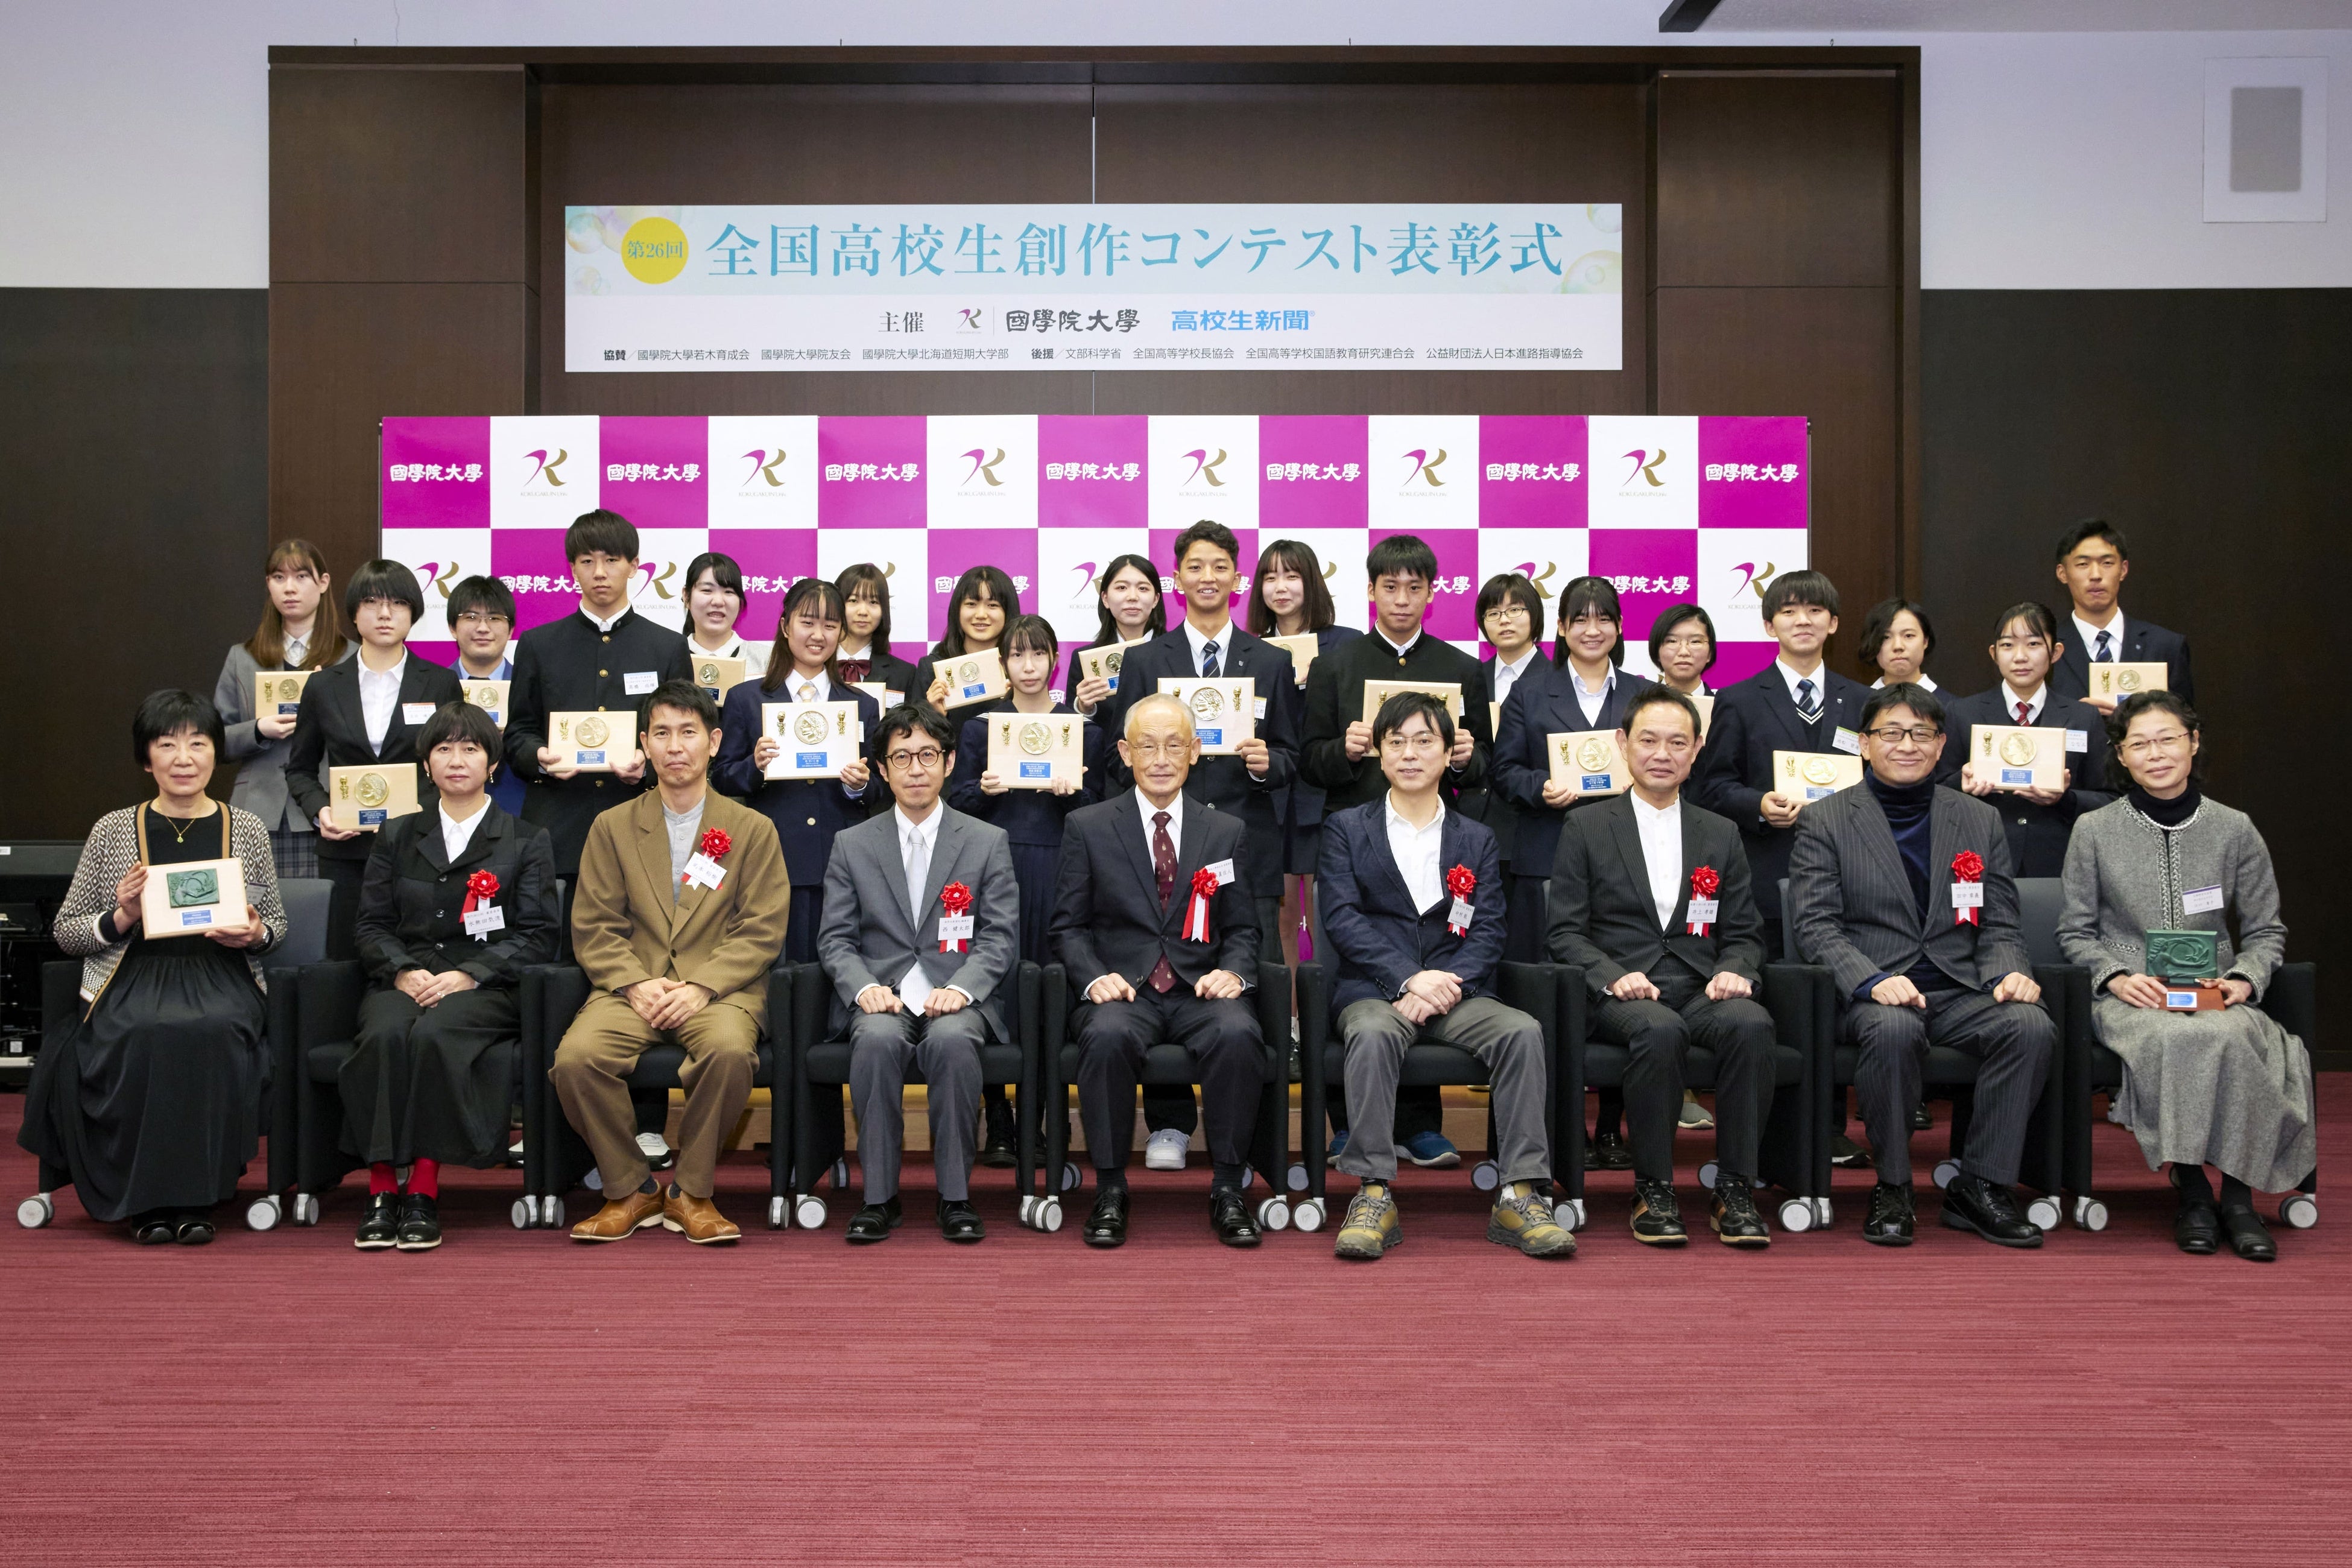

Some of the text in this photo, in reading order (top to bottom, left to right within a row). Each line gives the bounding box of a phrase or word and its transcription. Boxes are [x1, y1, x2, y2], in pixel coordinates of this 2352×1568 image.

[628, 241, 683, 258] 第26回
[706, 221, 1563, 277] 全国高校生創作コンテスト表彰式
[879, 311, 925, 334] 主催
[1006, 308, 1140, 334] 國學院大學
[761, 349, 851, 361] 國學院大學院友会
[862, 348, 1009, 360] 國學院大學北海道短期大学部
[1133, 347, 1234, 359] 全国高等学校長協会
[1245, 347, 1415, 359] 全国高等学校国語教育研究連合会
[1426, 347, 1584, 359] 公益財団法人日本進路指導協会
[390, 464, 482, 482] 國學院大學
[607, 464, 700, 482] 國學院大學
[826, 463, 919, 482] 國學院大學
[1046, 463, 1140, 481] 國學院大學
[1266, 463, 1361, 481] 國學院大學
[1487, 463, 1580, 481] 國學院大學
[1706, 464, 1798, 482] 國學院大學
